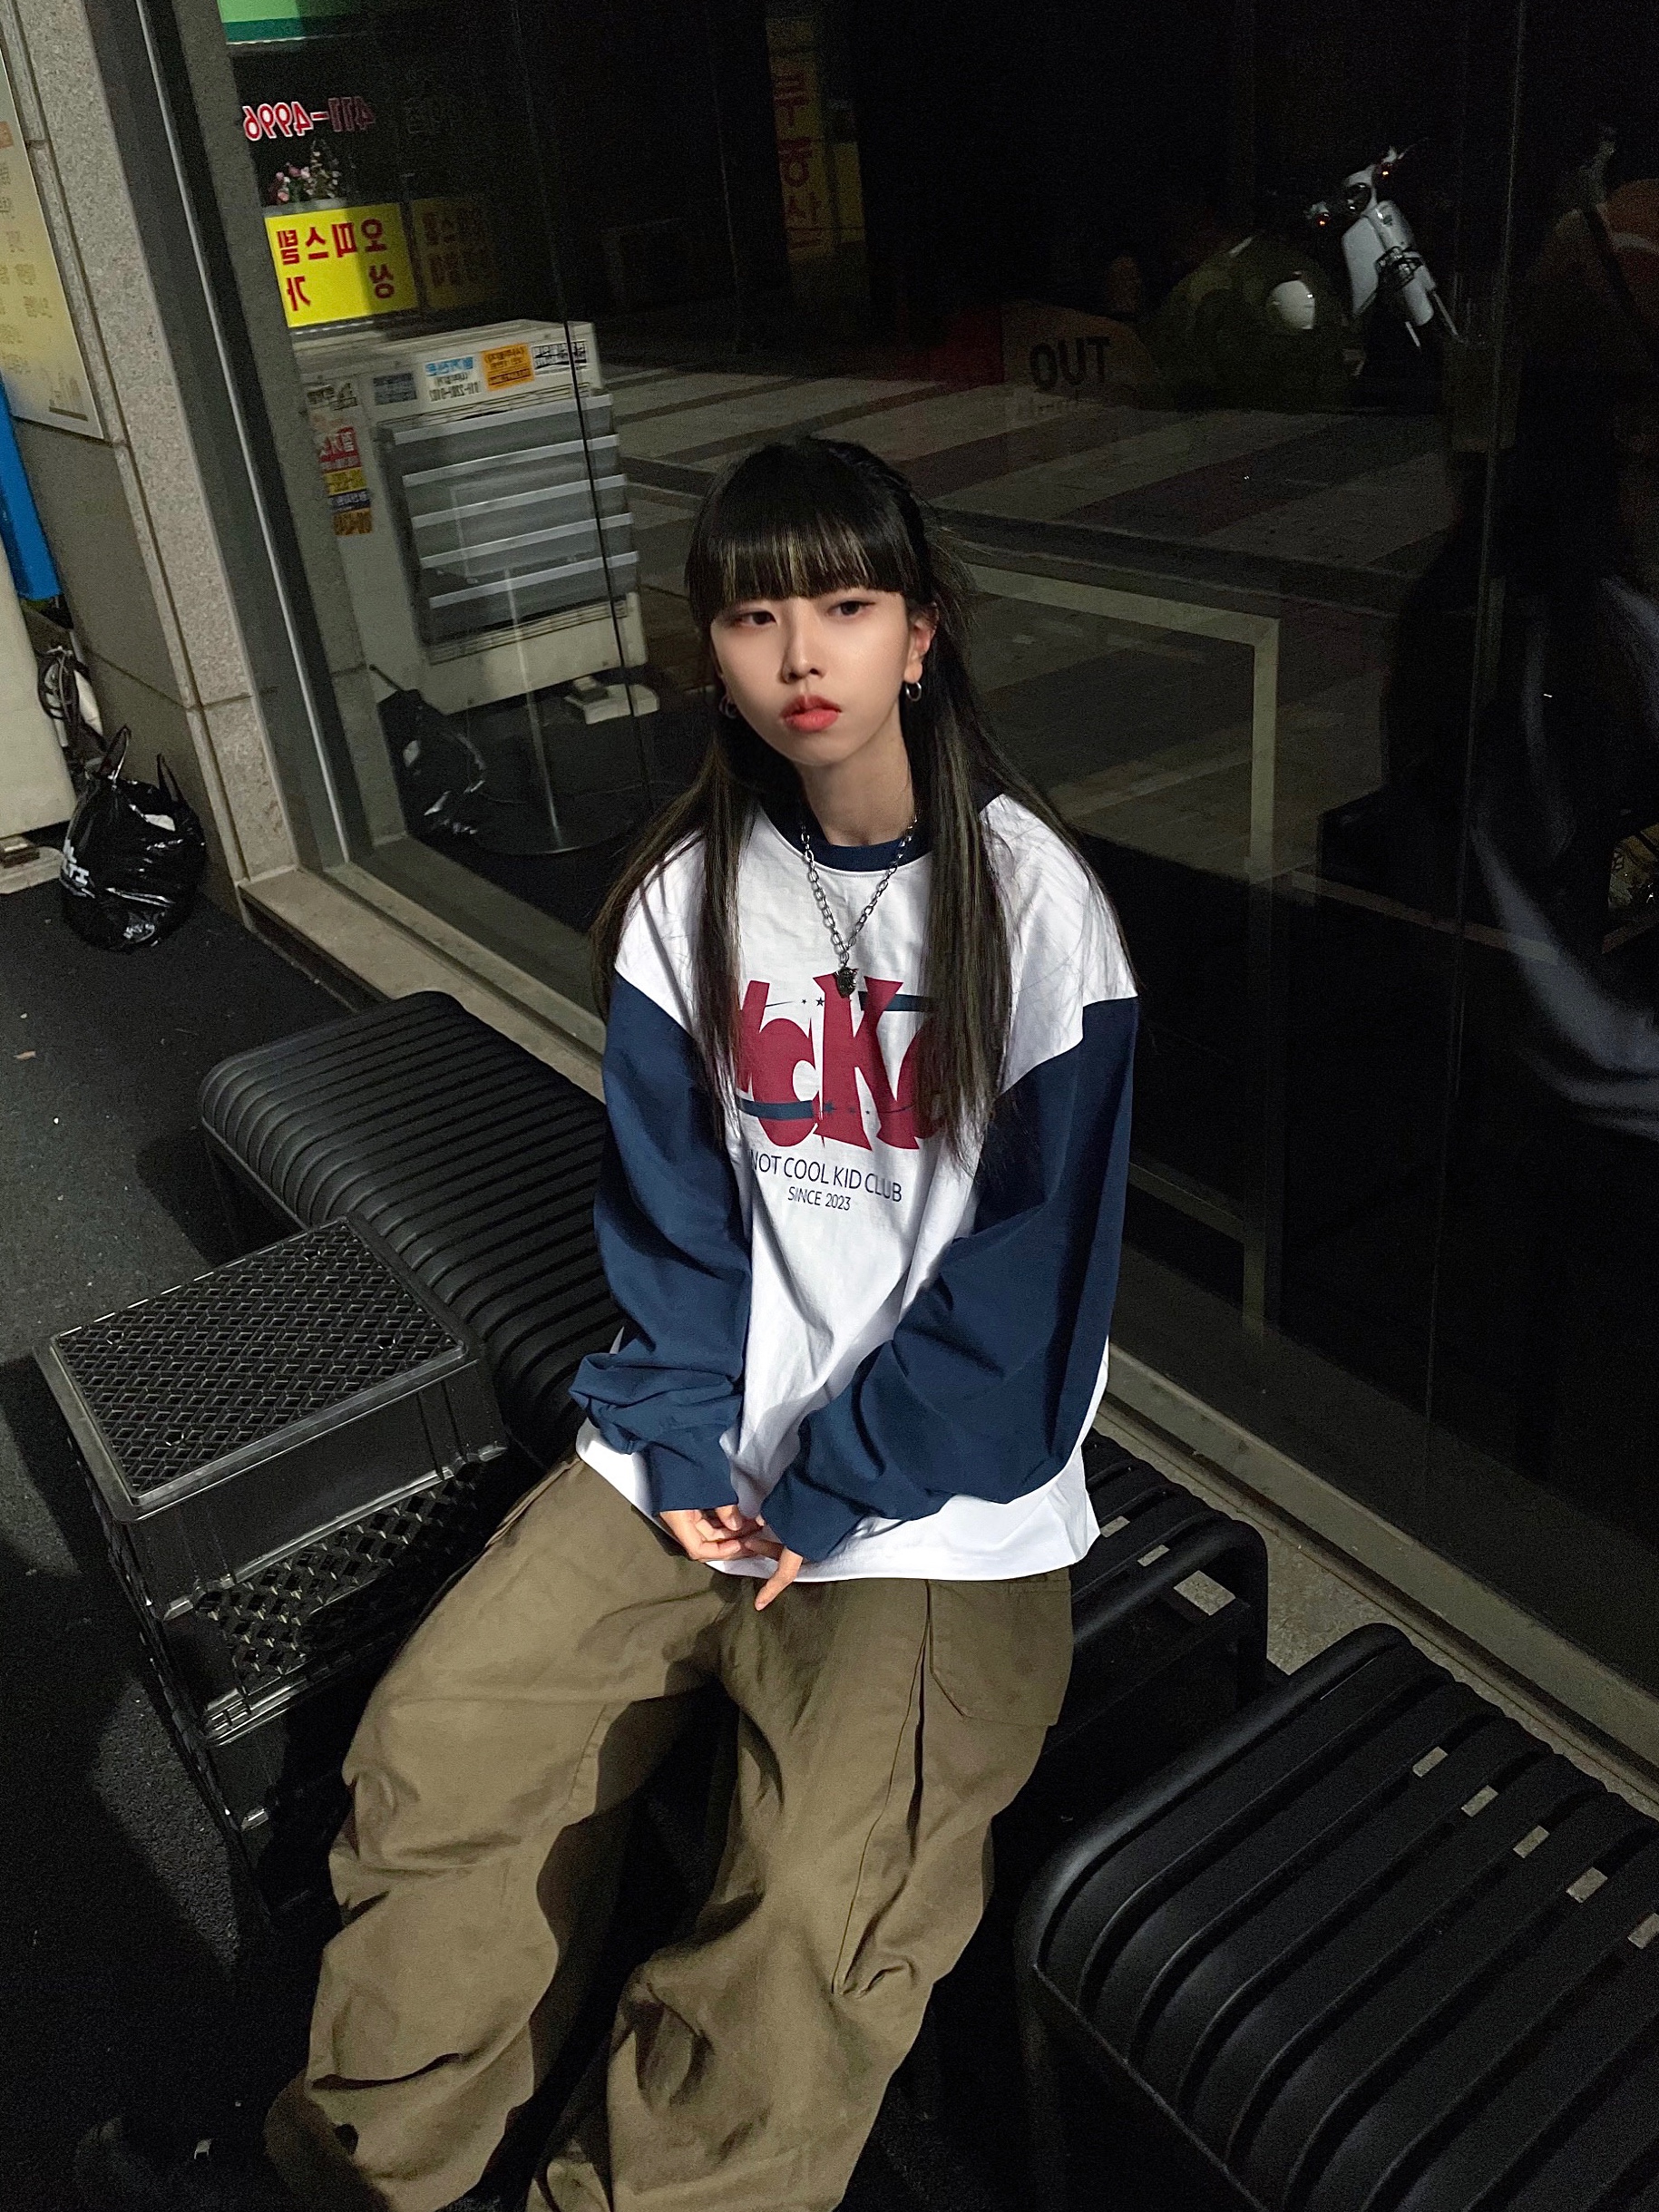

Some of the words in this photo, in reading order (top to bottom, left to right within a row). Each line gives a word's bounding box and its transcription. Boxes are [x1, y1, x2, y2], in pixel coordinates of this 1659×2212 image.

[1030, 336, 1111, 392] OUT
[750, 1149, 782, 1174] NOT
[784, 1157, 829, 1184] COOL
[833, 1165, 862, 1190] KID
[864, 1173, 903, 1203] CLUB
[787, 1186, 822, 1206] SINCE
[825, 1193, 851, 1211] 2023
